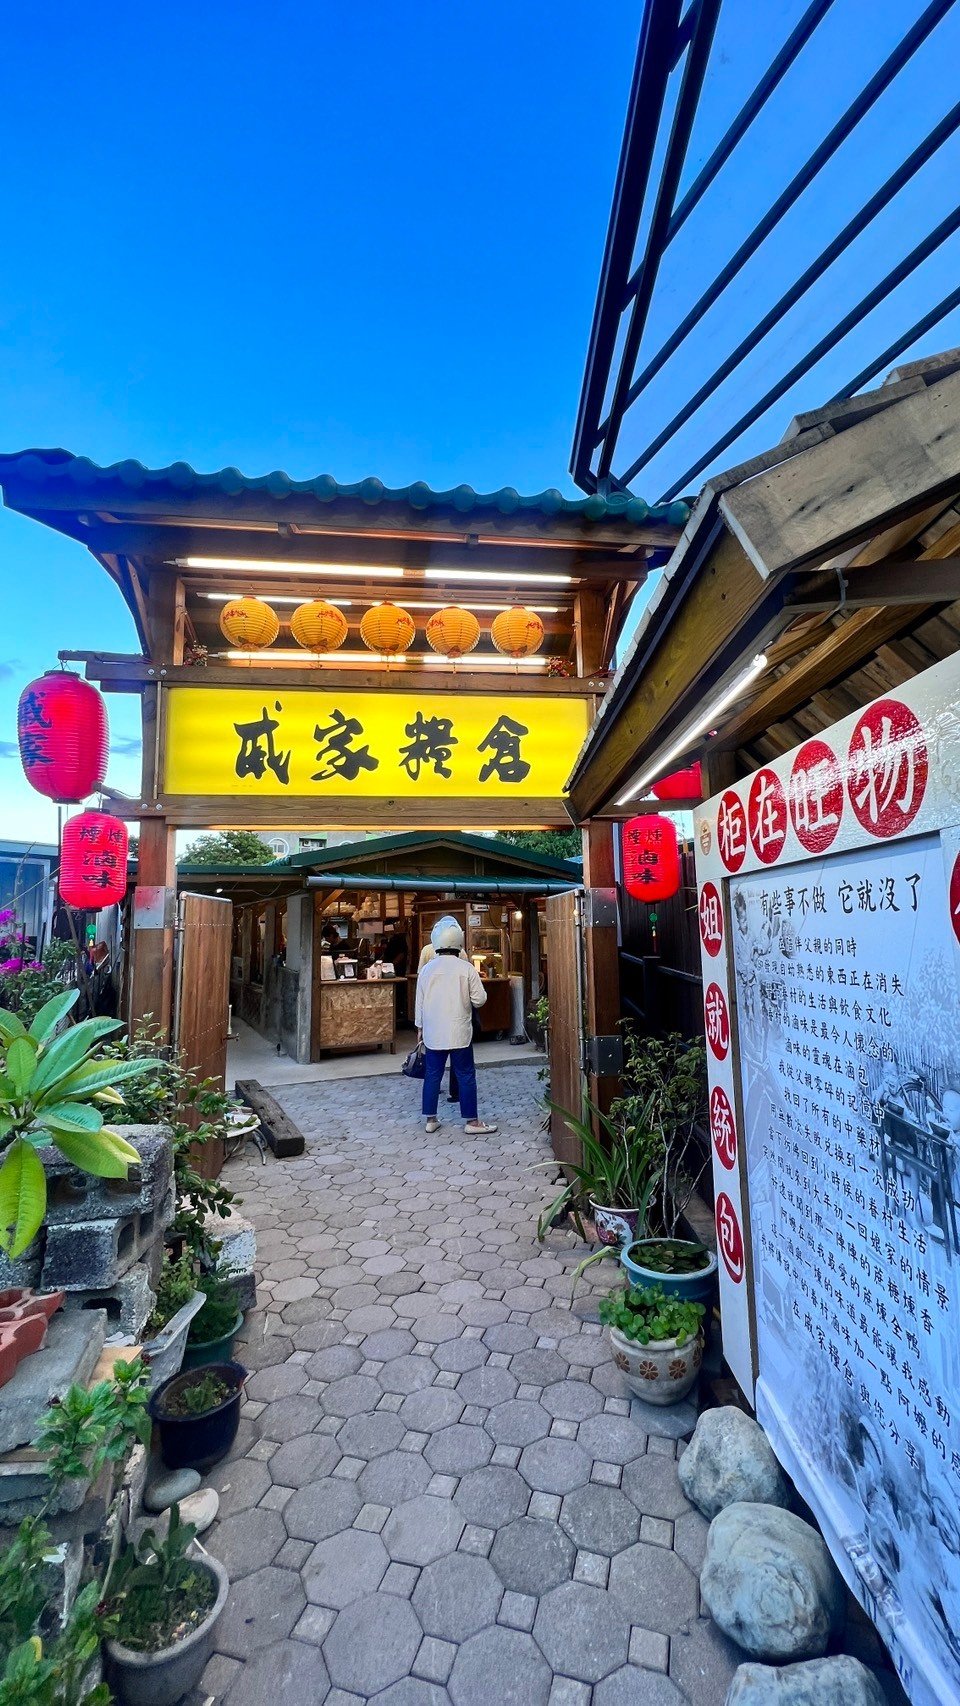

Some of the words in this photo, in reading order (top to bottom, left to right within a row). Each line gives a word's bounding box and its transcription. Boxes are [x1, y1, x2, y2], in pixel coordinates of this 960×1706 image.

[82, 850, 119, 889] 滷味
[759, 883, 827, 917] 有些事不做
[838, 872, 923, 913] 它就沒了
[784, 1037, 868, 1086] 滷味的靈魂在滷包
[783, 1086, 881, 1157] 找回了所有的中藥材
